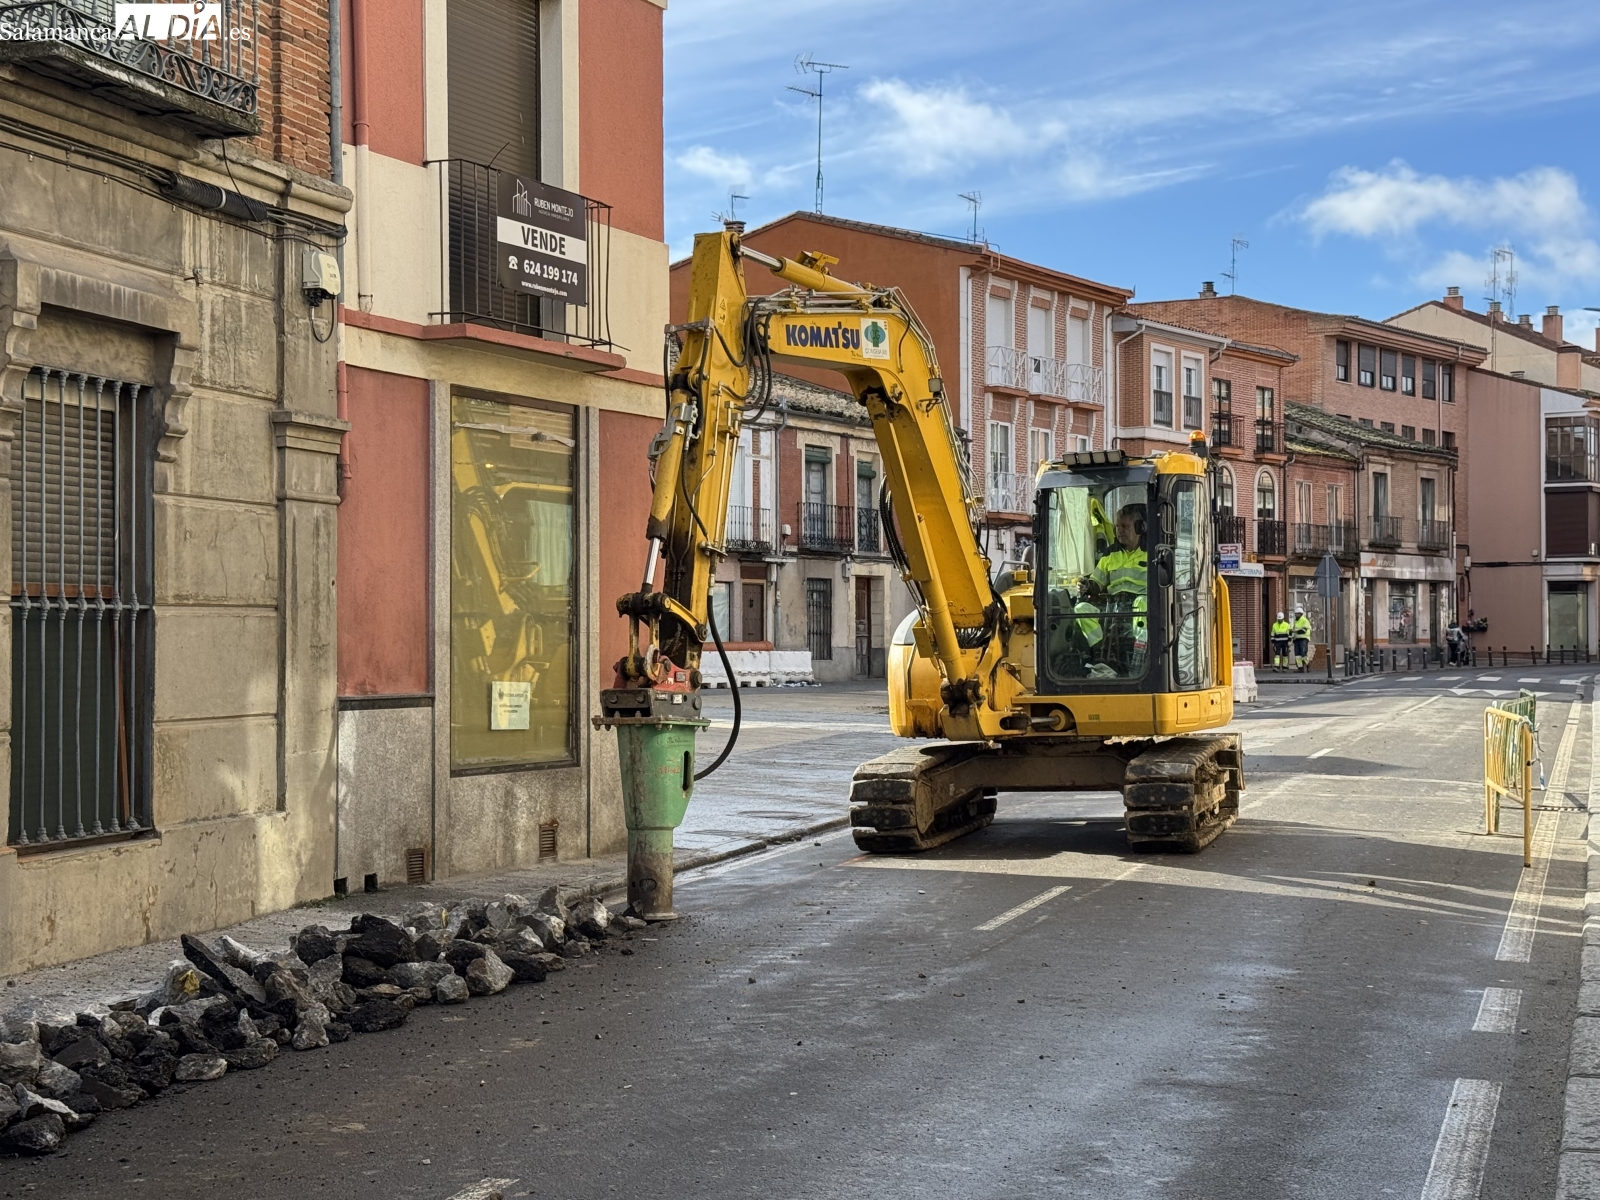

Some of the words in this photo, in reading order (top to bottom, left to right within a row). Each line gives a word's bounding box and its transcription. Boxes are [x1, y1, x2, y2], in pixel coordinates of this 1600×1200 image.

[550, 202, 574, 218] MONTEJO
[521, 225, 566, 255] VENDE
[523, 259, 541, 277] 624
[542, 264, 560, 281] 199
[561, 269, 578, 286] 174
[785, 321, 860, 349] KOMATSU
[1220, 545, 1238, 554] SR
